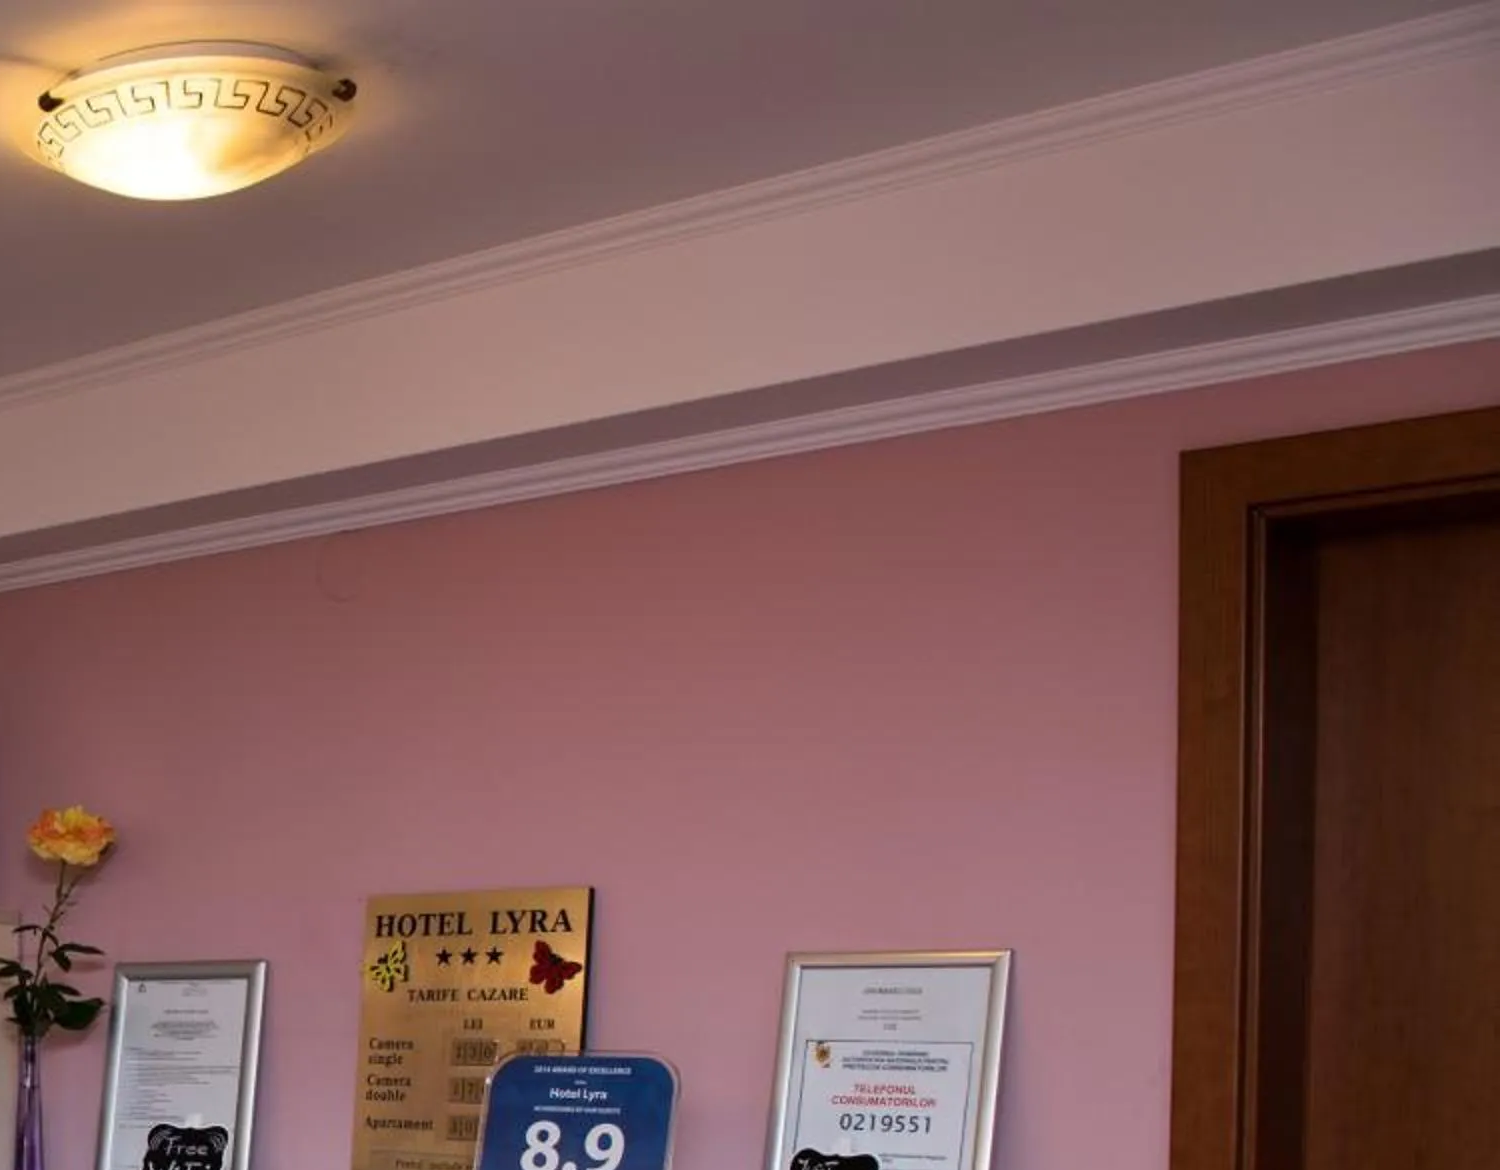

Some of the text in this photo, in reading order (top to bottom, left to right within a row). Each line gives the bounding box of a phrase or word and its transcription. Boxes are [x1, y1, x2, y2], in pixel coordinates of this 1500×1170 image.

[375, 909, 572, 938] HOTEL LYRA
[408, 988, 529, 1002] TARIFE CAZARE
[464, 1018, 483, 1030] LEI
[530, 1018, 554, 1030] EUR
[369, 1037, 414, 1050] Camera
[367, 1074, 411, 1087] Camera
[550, 1087, 607, 1102] Hotel Lyra
[853, 1083, 916, 1096] TELEFONUL
[831, 1095, 937, 1109] CONSUMATORILOR
[839, 1112, 931, 1134] 0219551
[164, 1136, 209, 1156] Free
